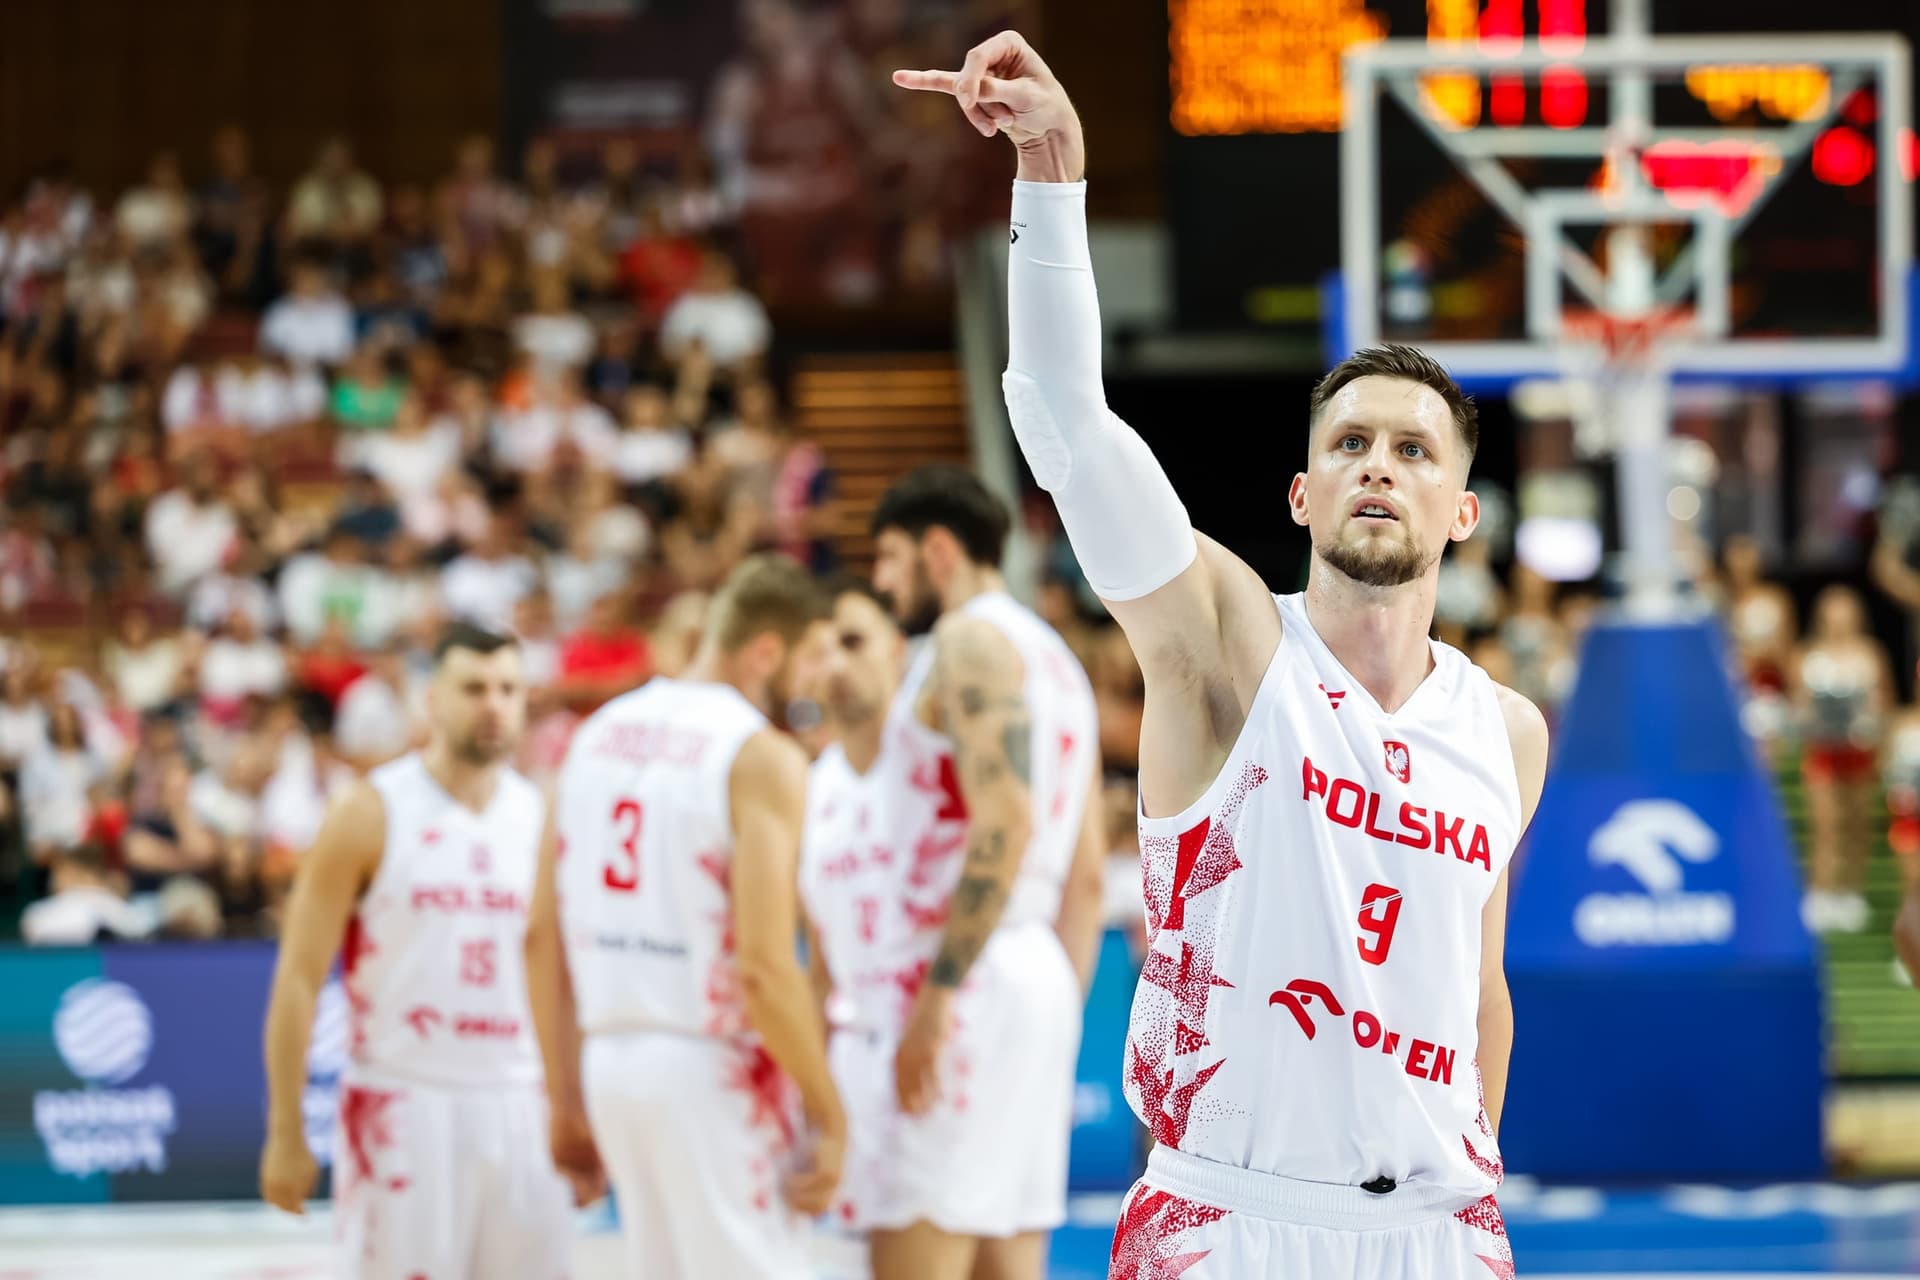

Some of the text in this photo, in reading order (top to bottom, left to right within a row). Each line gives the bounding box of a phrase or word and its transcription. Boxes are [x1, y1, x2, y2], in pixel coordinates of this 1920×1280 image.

[604, 797, 642, 891] 3
[1302, 756, 1491, 872] POLSKA
[1357, 882, 1403, 966] 9
